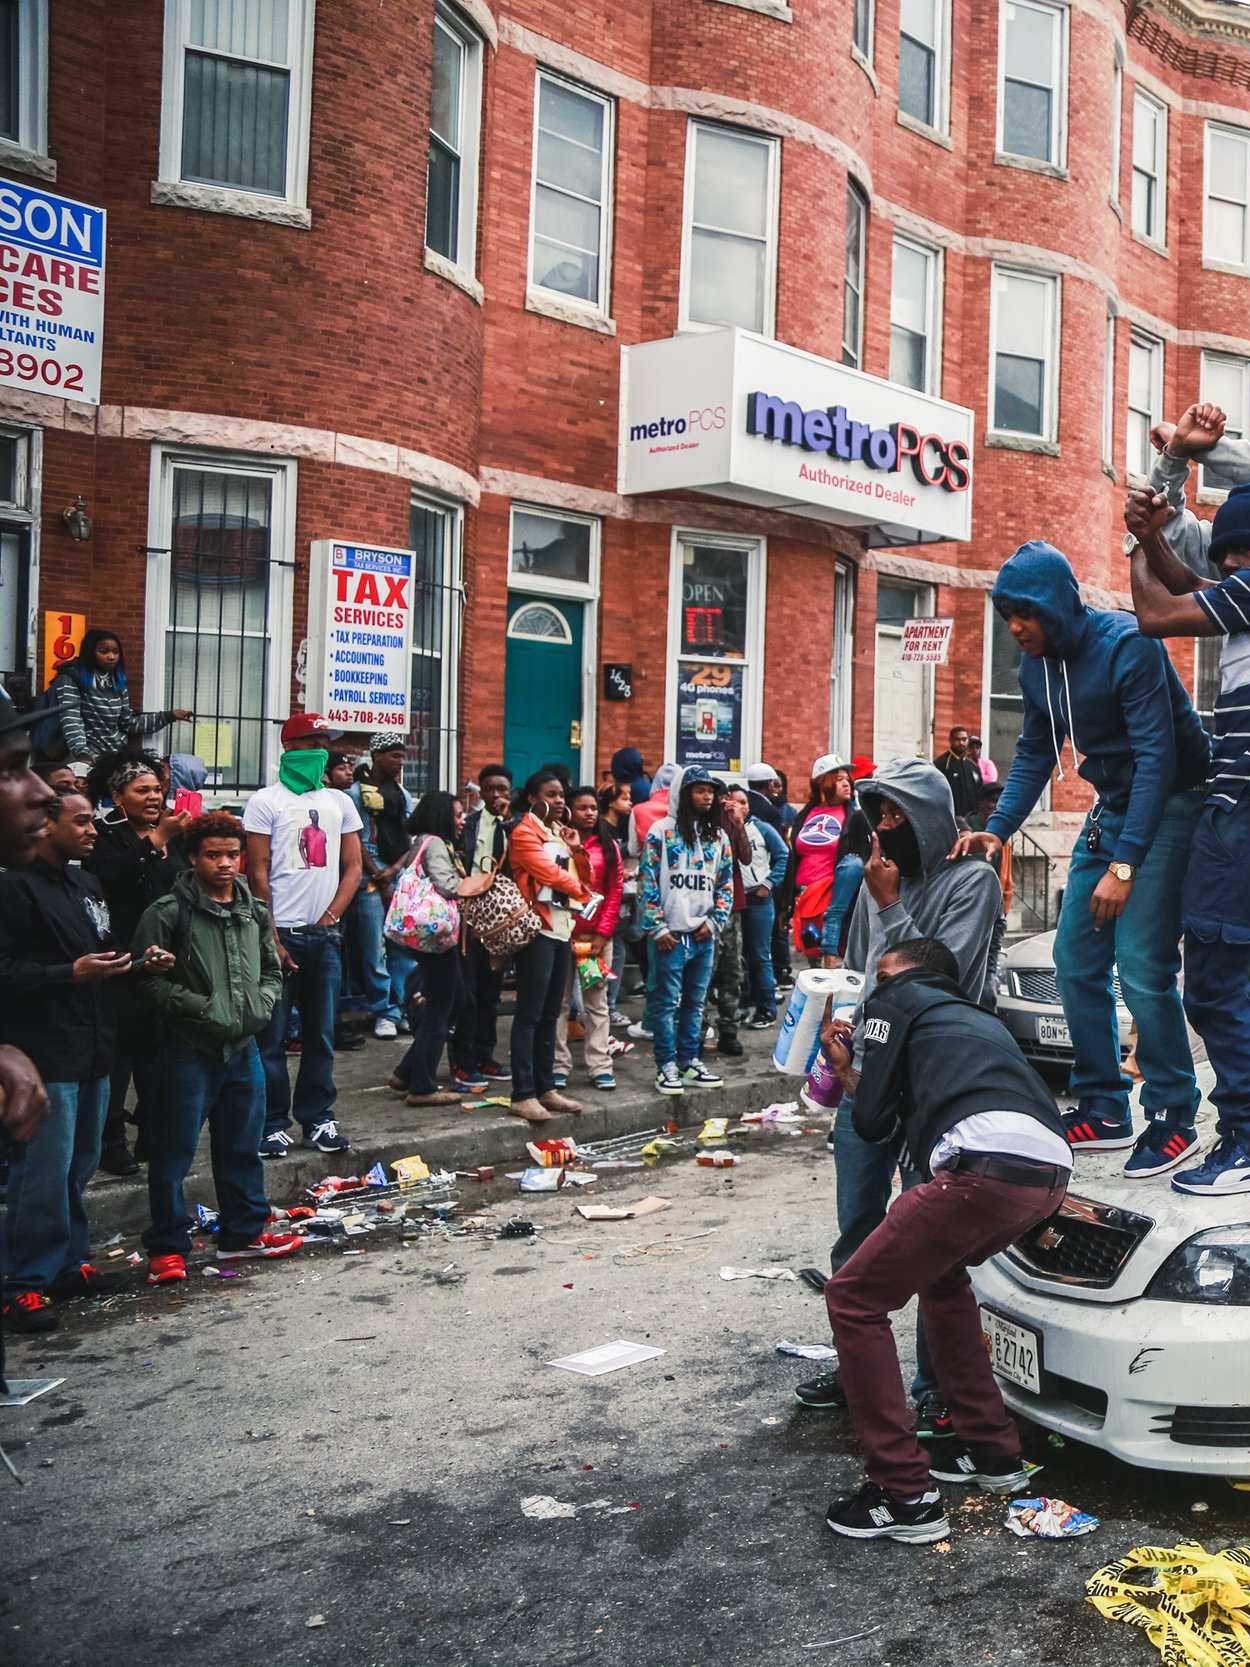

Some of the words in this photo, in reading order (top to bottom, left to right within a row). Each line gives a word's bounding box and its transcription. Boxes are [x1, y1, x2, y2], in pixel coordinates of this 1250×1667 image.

[0, 244, 100, 295] CARE
[36, 319, 95, 344] HUMAN
[649, 444, 679, 454] Authorized
[681, 442, 699, 451] Dealer
[746, 391, 971, 492] metroPCS
[799, 464, 872, 496] Authorized
[875, 483, 916, 507] Dealer
[354, 561, 365, 569] TAX
[355, 550, 402, 566] BRYSON
[332, 569, 409, 609] TAX
[683, 583, 724, 602] OPEN
[334, 607, 404, 629] SERVICES
[336, 630, 350, 644] TAX
[352, 632, 404, 648] PREPARATION
[903, 626, 950, 639] APARTMENT
[904, 641, 920, 651] FOR
[922, 640, 943, 651] RENT
[335, 650, 385, 666] ACCOUNTING
[334, 669, 388, 686] BOOKKEEPING
[690, 663, 731, 687] 29
[680, 682, 696, 692] 4G
[697, 683, 734, 694] phones
[334, 689, 367, 703] PAYROLL
[369, 691, 405, 706] SERVICES
[328, 709, 405, 725] 443-708-2456
[1003, 1337, 1034, 1379] 2742
